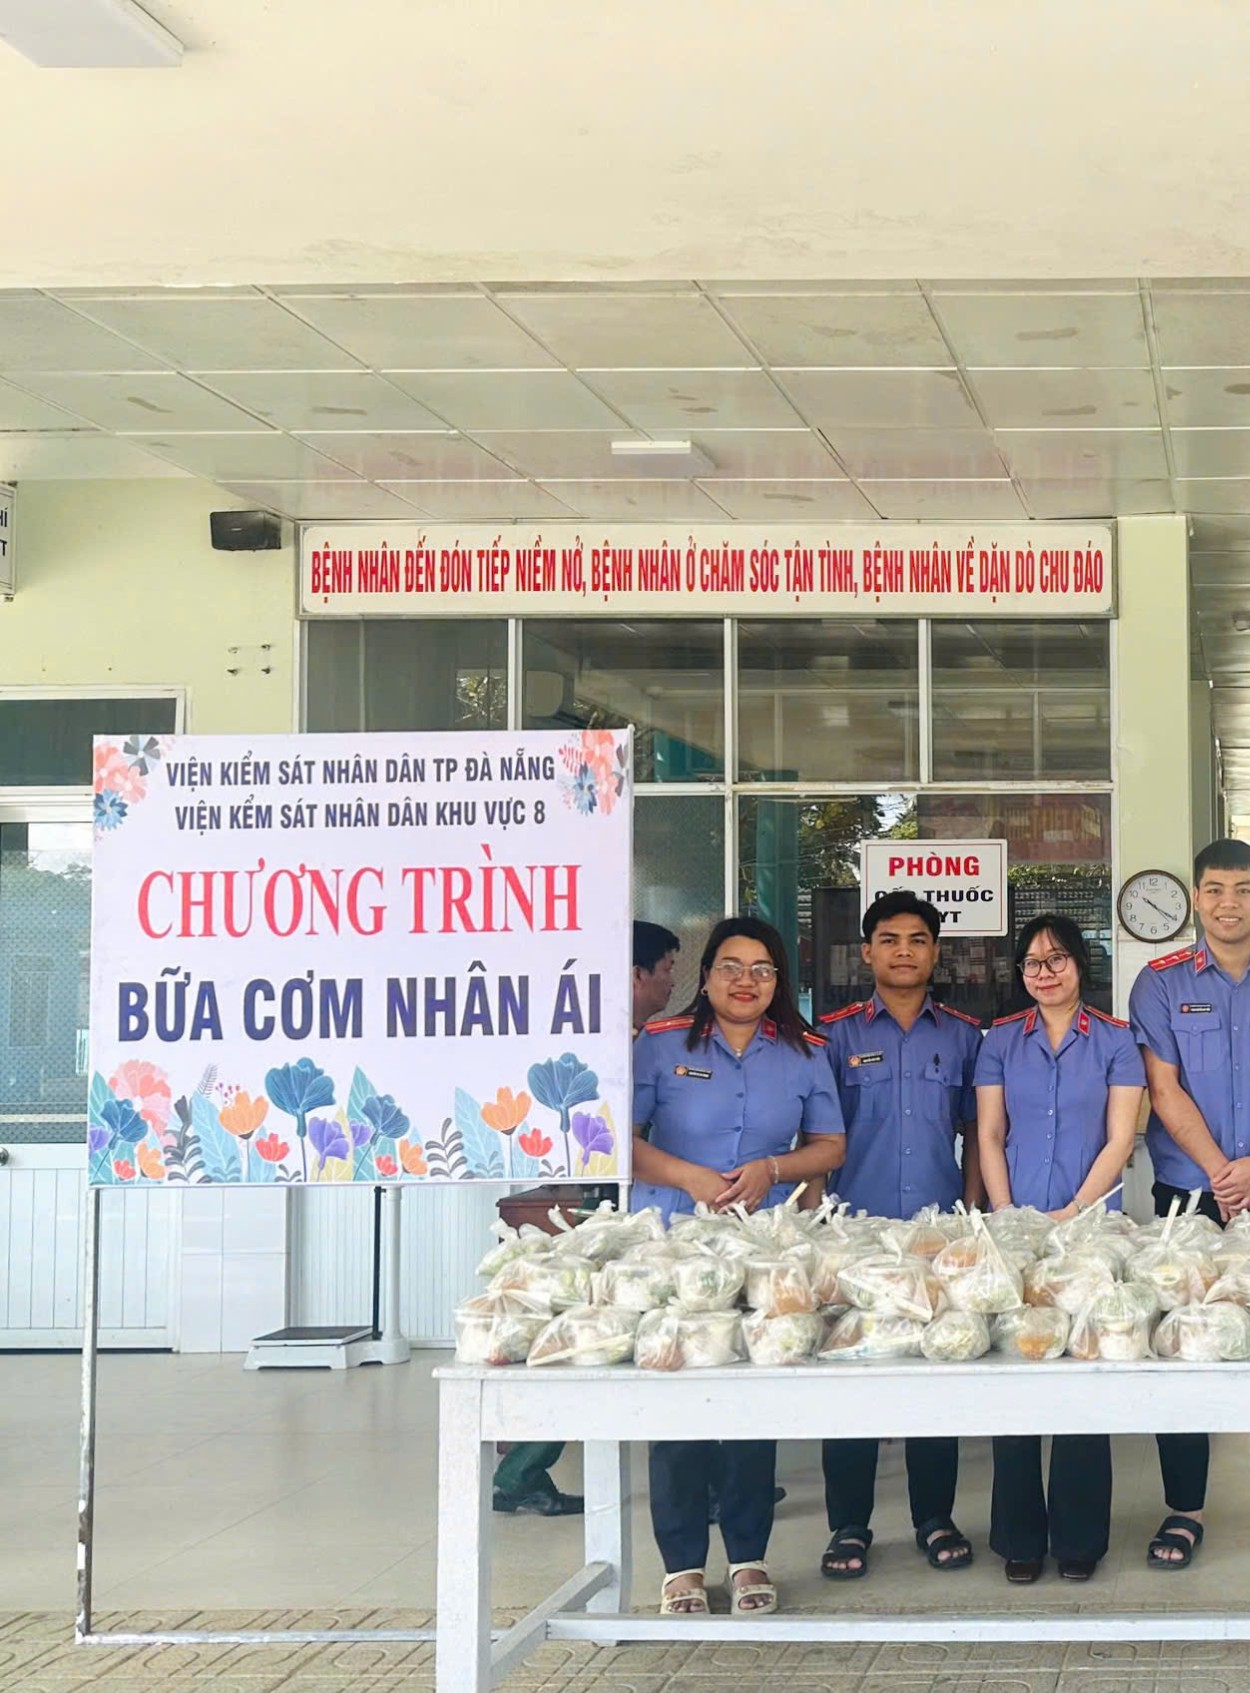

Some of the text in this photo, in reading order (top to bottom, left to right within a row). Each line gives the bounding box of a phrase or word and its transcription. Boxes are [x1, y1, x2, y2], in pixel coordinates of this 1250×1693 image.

[311, 534, 1104, 603] BỆNH NHÂN ĐẾN ĐÓN TIẾP NIỀM NỞ, BỆNH NHÂN Ở CHĂM SÓC TẬN TÌNH, BỆNH NHÂN VỀ DẶN DÒ CHU ĐÁO
[166, 748, 556, 792] VIỆN KIỂM SÁT NHÂN DÂN TP ĐÀ NẴNG
[175, 794, 546, 836] VIỆN KỂM SÁT NHÂN DÂN KHU VỰC 8
[889, 851, 980, 877] PHÒNG
[1149, 878, 1159, 886] 12
[137, 843, 583, 939] CHƯƠNG TRÌNH
[923, 885, 994, 902] THUỐC
[1129, 890, 1139, 898] 10
[1170, 890, 1178, 898] 2
[1125, 902, 1133, 910] 9
[1175, 902, 1182, 910] 3
[939, 911, 962, 923] YT
[1129, 914, 1137, 922] 8
[1150, 926, 1158, 934] 6
[1163, 923, 1170, 931] 5
[118, 958, 601, 1042] BỮA CƠM NHÂN ÁI
